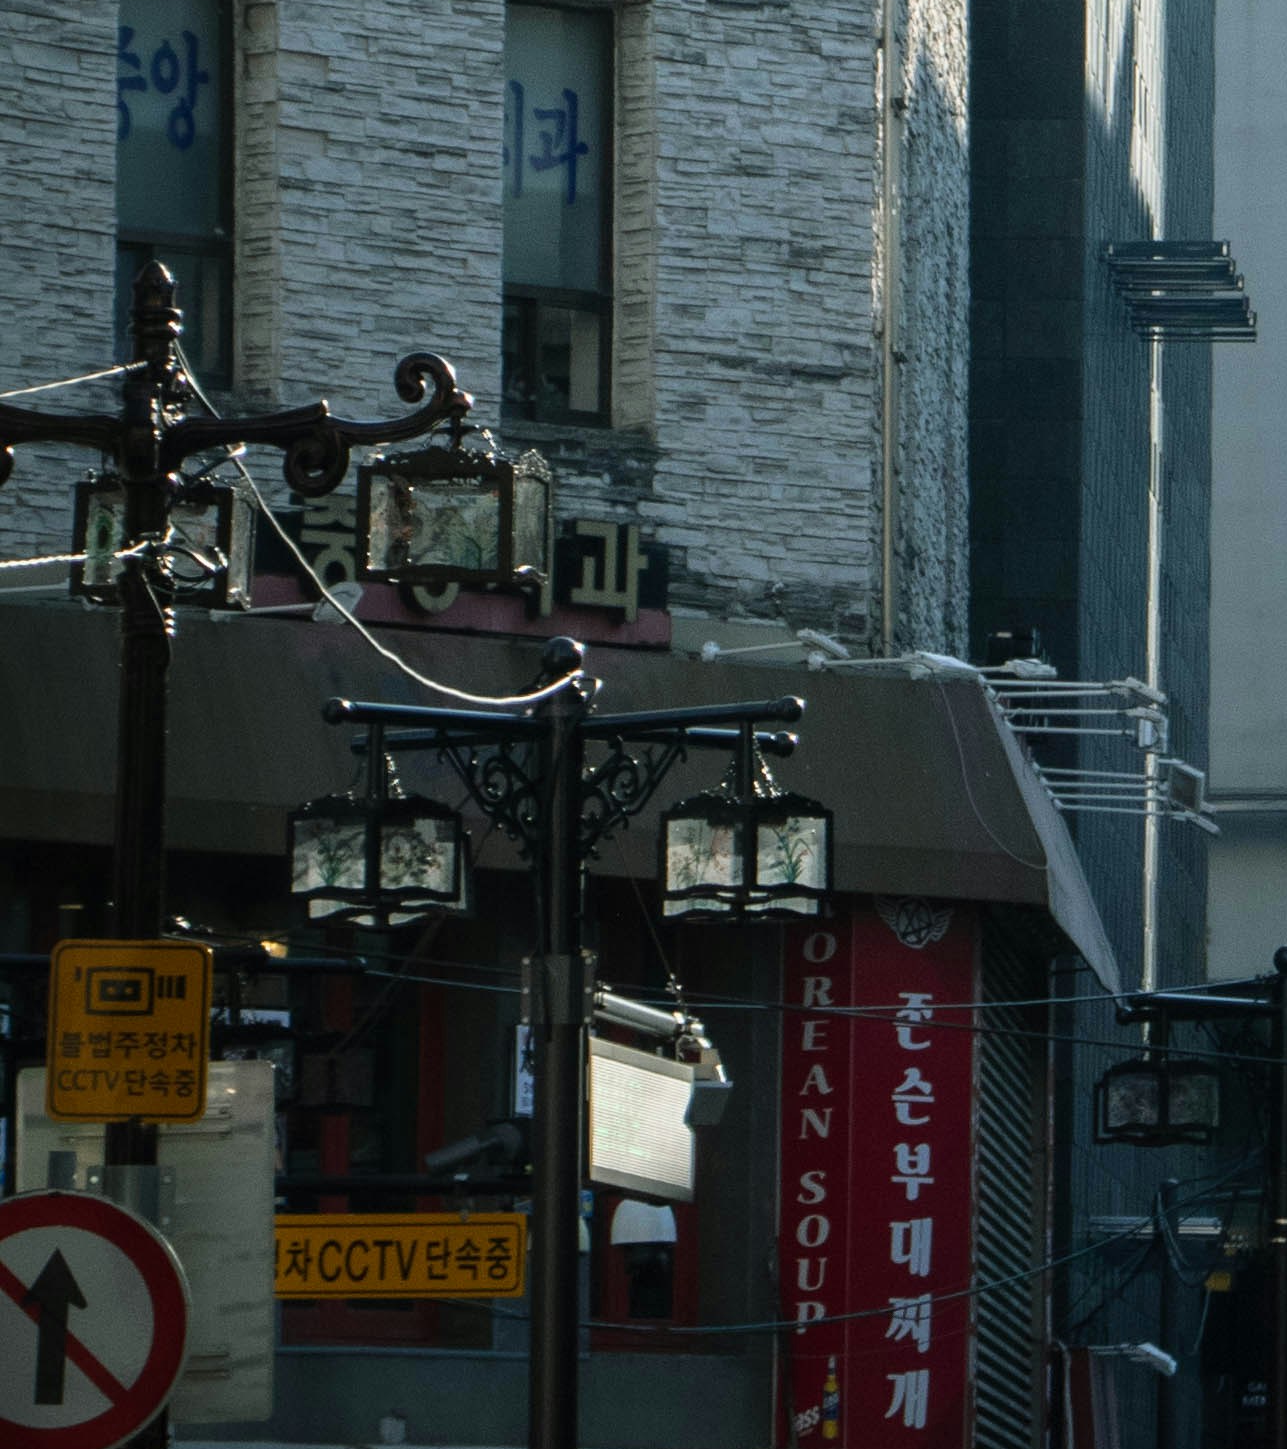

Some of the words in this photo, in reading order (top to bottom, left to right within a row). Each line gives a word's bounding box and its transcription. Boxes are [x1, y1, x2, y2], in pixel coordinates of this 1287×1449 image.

[58, 1030, 198, 1061] 불법주정차
[798, 907, 836, 1141] OREAN
[795, 1169, 831, 1336] SOUP
[885, 992, 936, 1431] 존슨부대찌개
